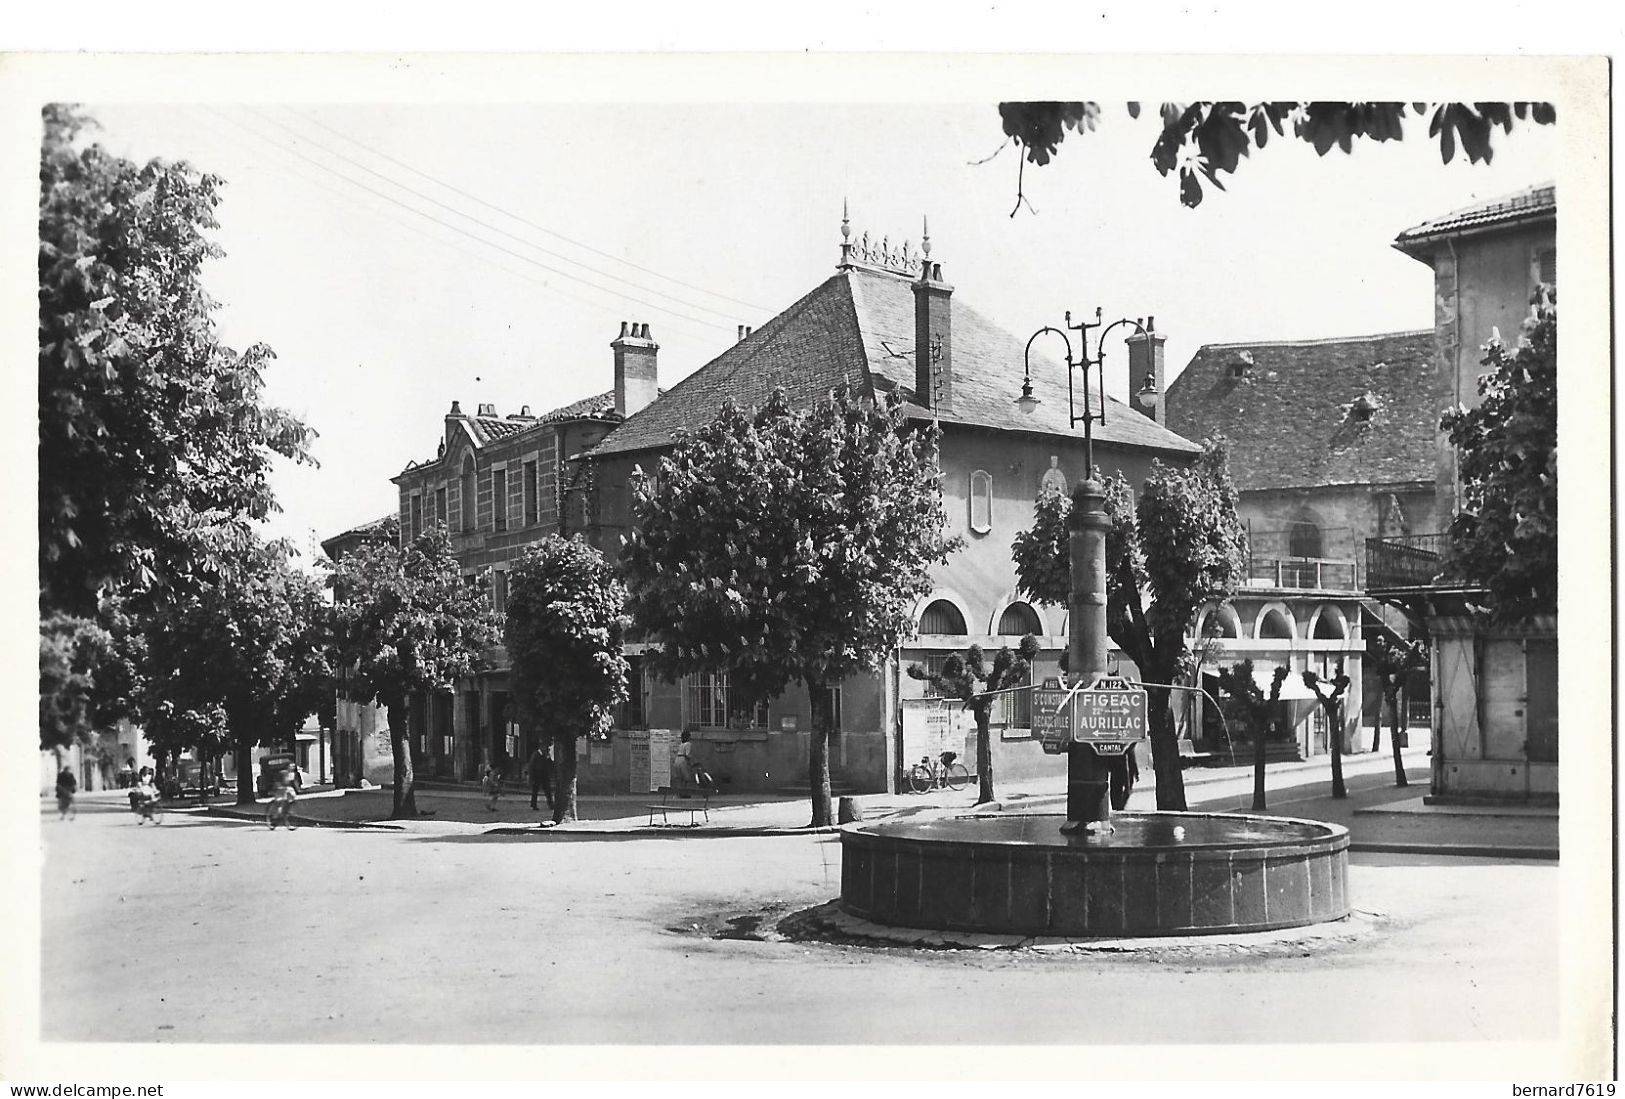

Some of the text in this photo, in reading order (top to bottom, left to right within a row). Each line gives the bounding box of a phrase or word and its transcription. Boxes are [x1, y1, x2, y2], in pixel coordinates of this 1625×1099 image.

[1100, 680, 1122, 690] N.122
[1083, 694, 1140, 707] FIGEAC
[1080, 716, 1141, 729] AURILLAC
